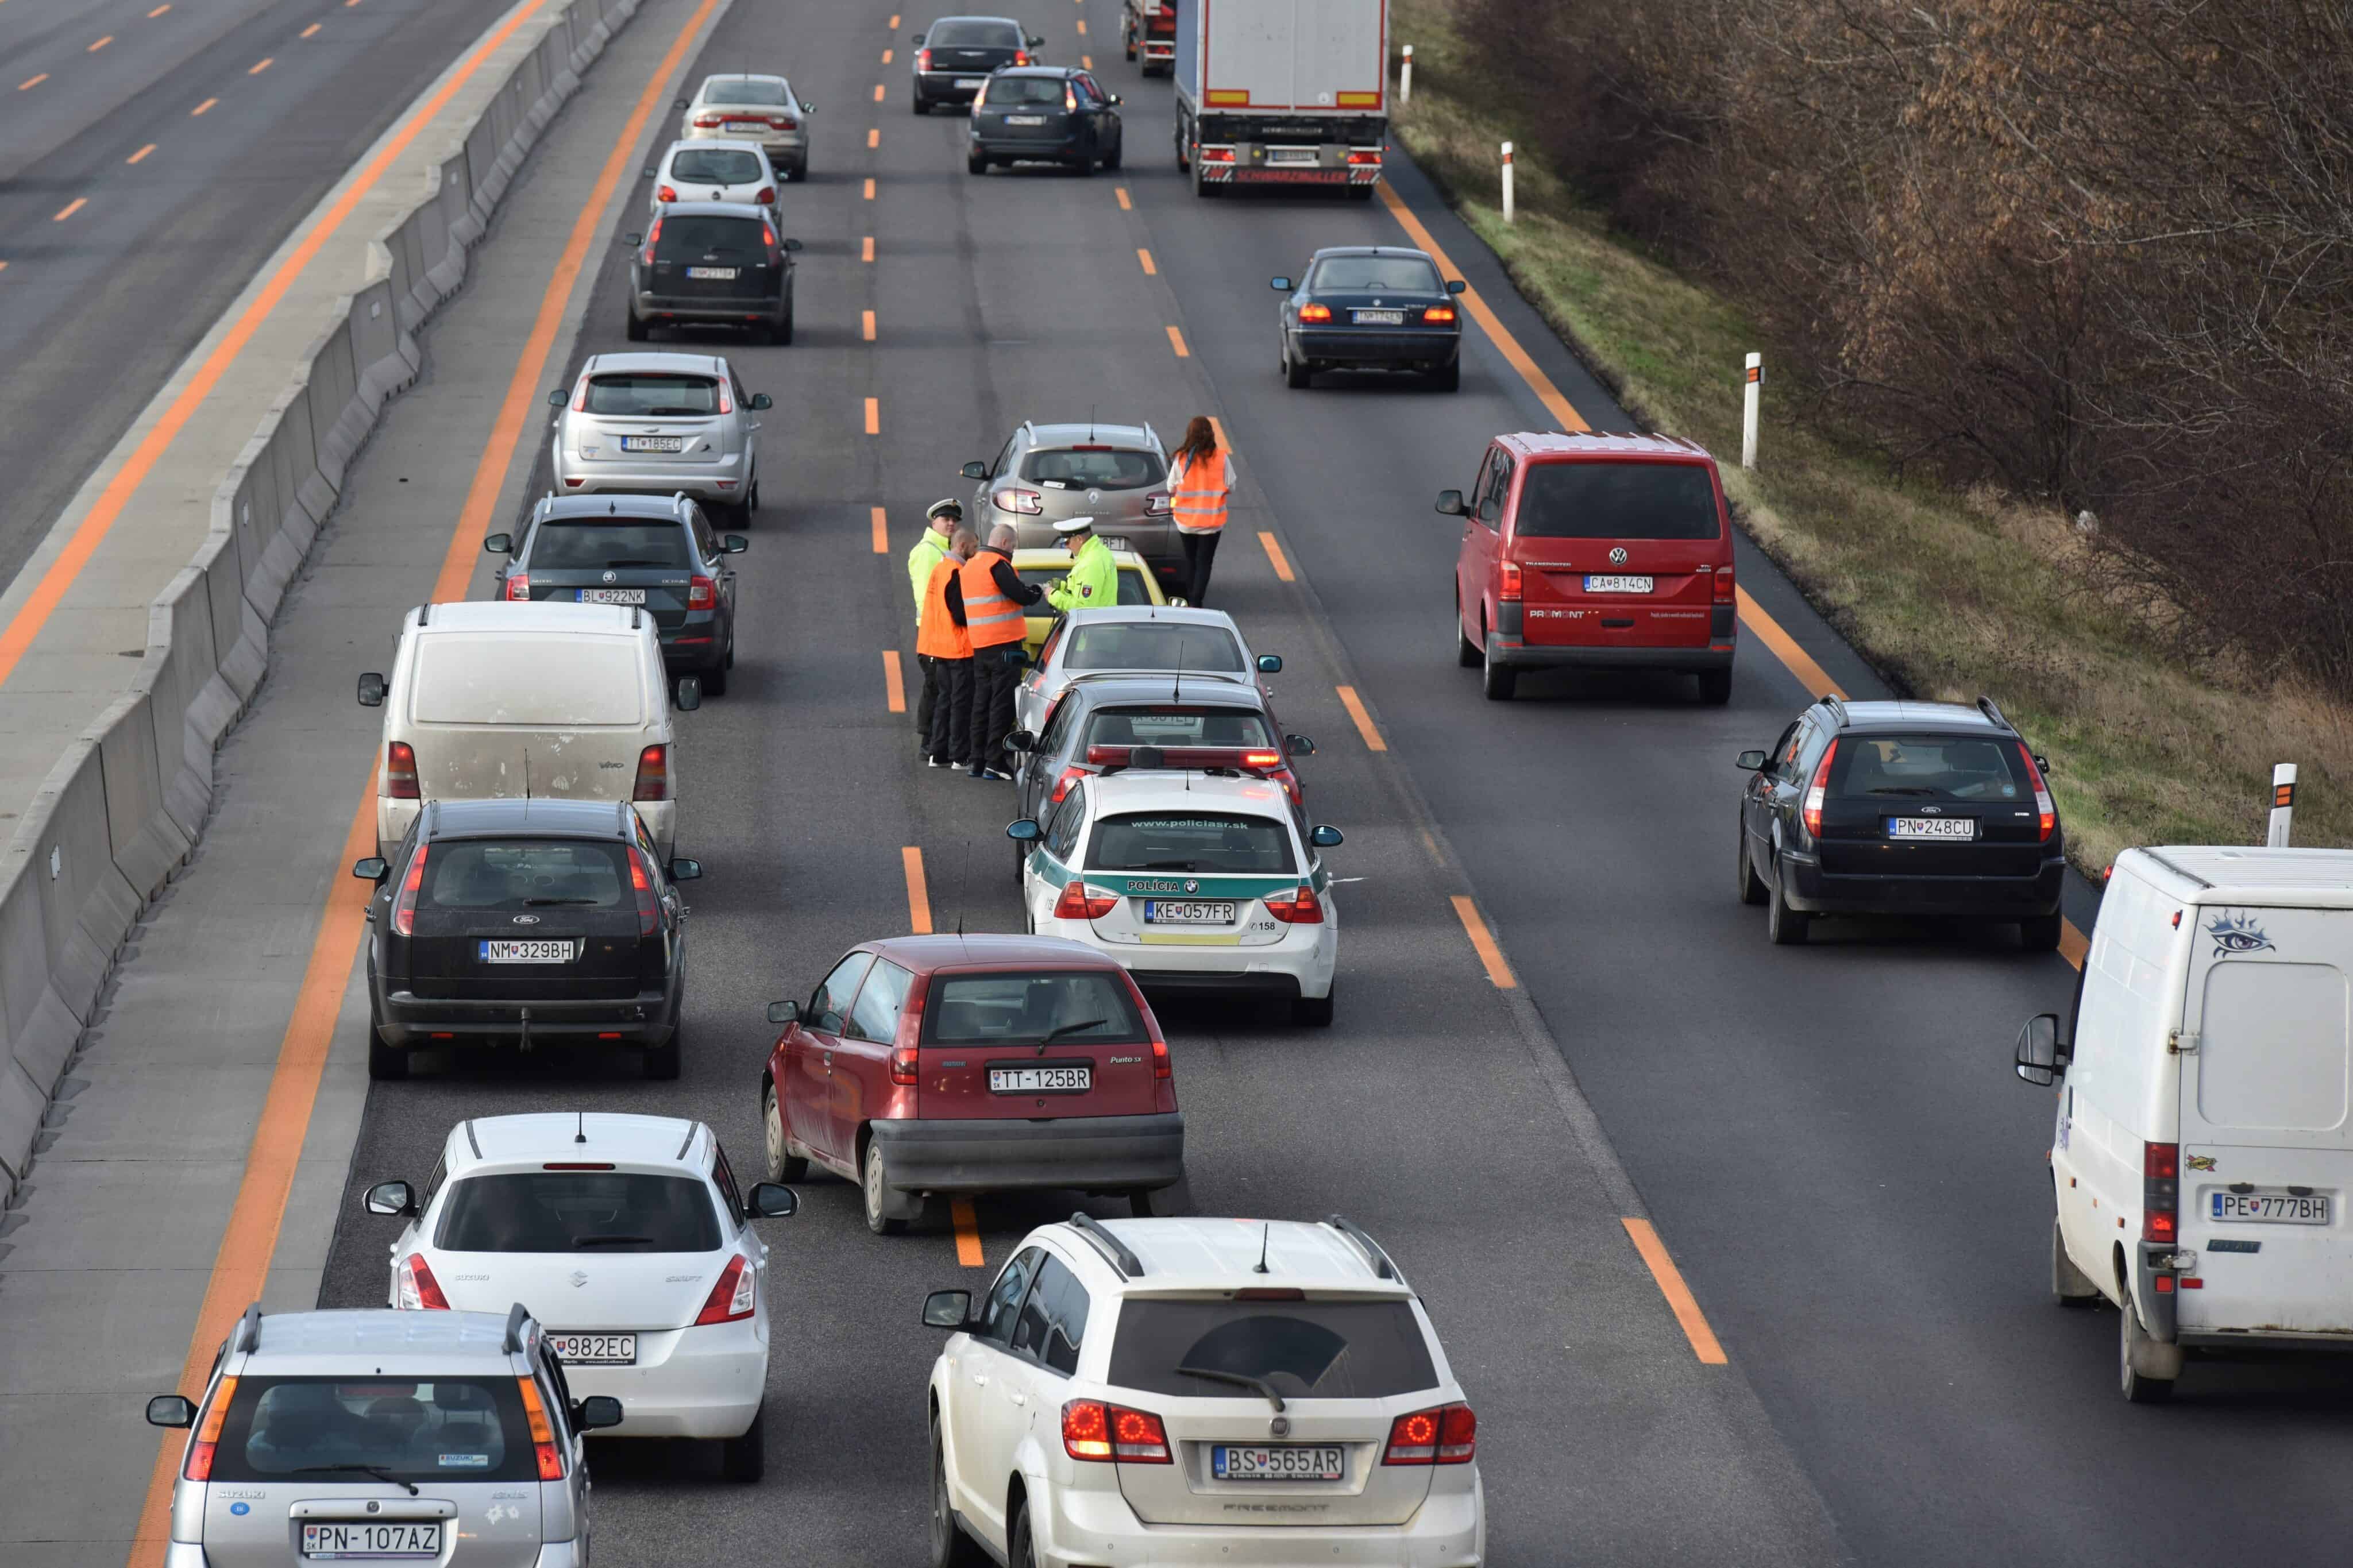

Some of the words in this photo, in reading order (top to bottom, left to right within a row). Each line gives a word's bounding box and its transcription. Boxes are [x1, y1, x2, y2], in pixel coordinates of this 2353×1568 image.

[629, 438, 641, 449] TT
[1592, 578, 1606, 589] CA
[1613, 578, 1651, 589] 814CN
[584, 590, 597, 602] BL
[605, 590, 643, 603] 922NK
[1530, 610, 1584, 619] PROMONT
[1131, 820, 1248, 830] www.policiasr.sk
[1899, 820, 1916, 833] PN
[1926, 820, 1972, 834] 248CU
[1127, 879, 1179, 892] POLÍCIA
[1156, 903, 1174, 918] KE
[1183, 903, 1232, 919] 057FR
[491, 943, 511, 958] NM
[520, 943, 571, 958] 329BH
[1110, 1056, 1133, 1064] Punto
[2224, 1197, 2248, 1216] PE
[2261, 1199, 2324, 1218] 777BH
[454, 1273, 489, 1281] SUZUKI
[568, 1338, 631, 1357] 982EC
[1229, 1450, 1256, 1471] BS
[1268, 1450, 1338, 1472] 565AR
[218, 1490, 265, 1499] SUZUKI
[319, 1527, 437, 1550] PN-107AZ
